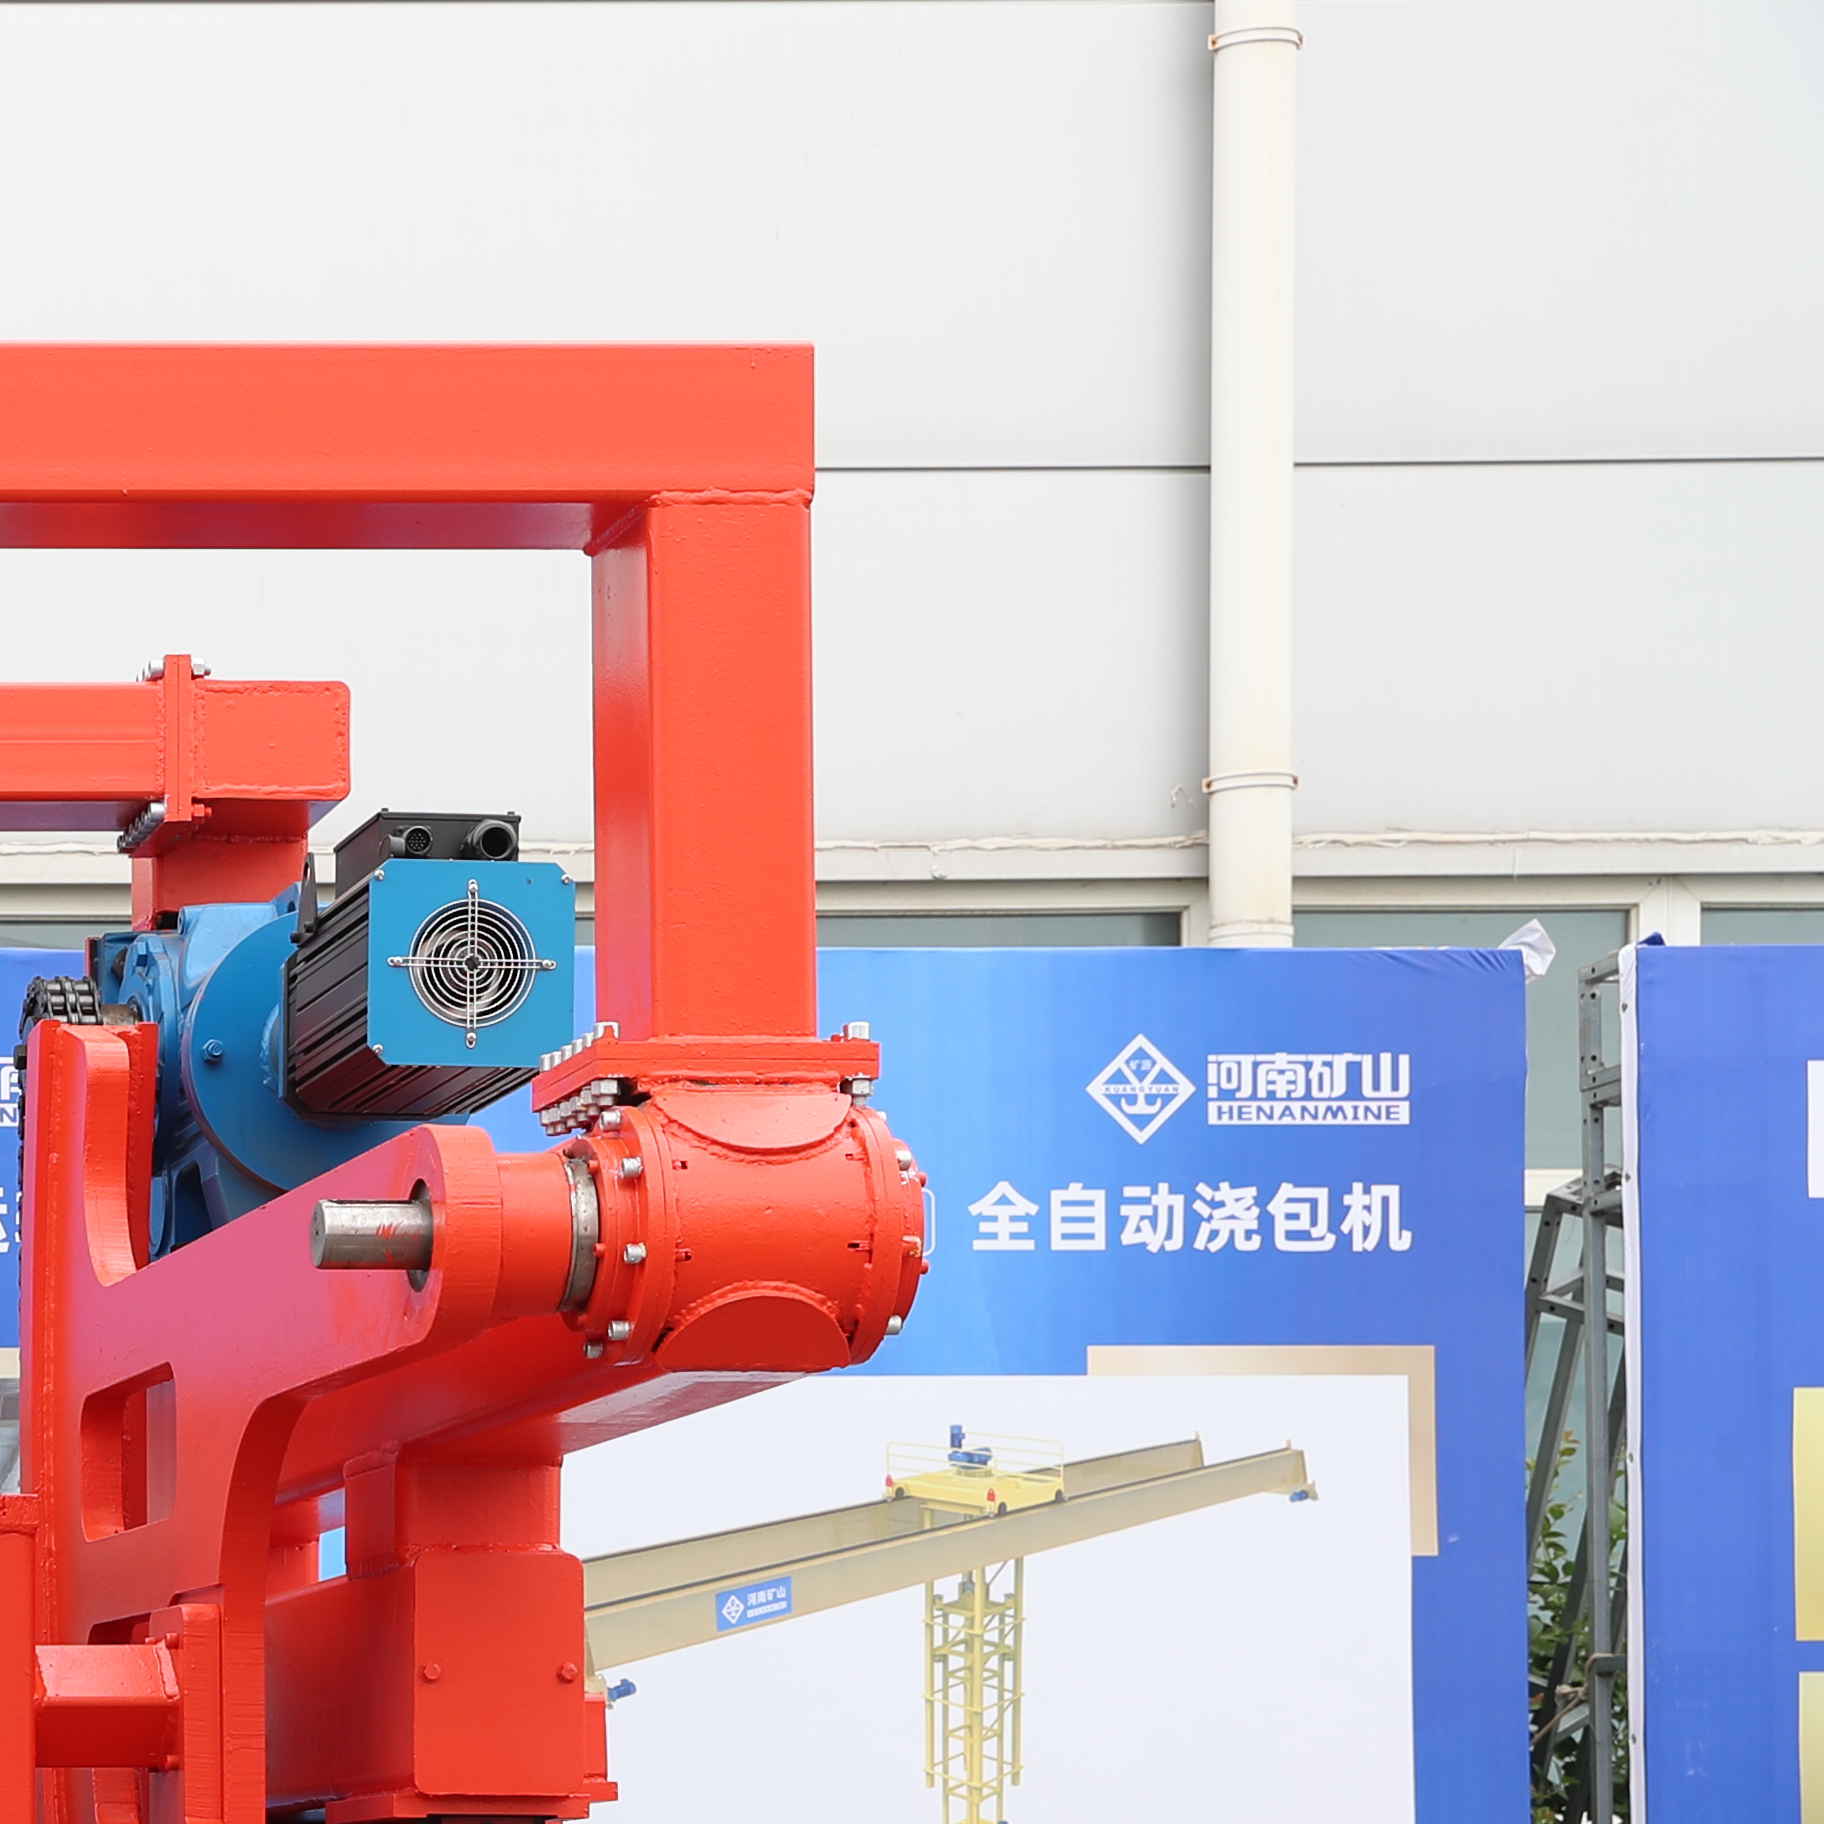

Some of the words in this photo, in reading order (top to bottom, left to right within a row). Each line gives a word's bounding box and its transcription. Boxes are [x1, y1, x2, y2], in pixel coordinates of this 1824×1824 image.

[1207, 1052, 1410, 1099] 河南矿山
[1216, 1104, 1401, 1121] HENANMINE
[968, 1180, 1413, 1254] 全自动浇包机
